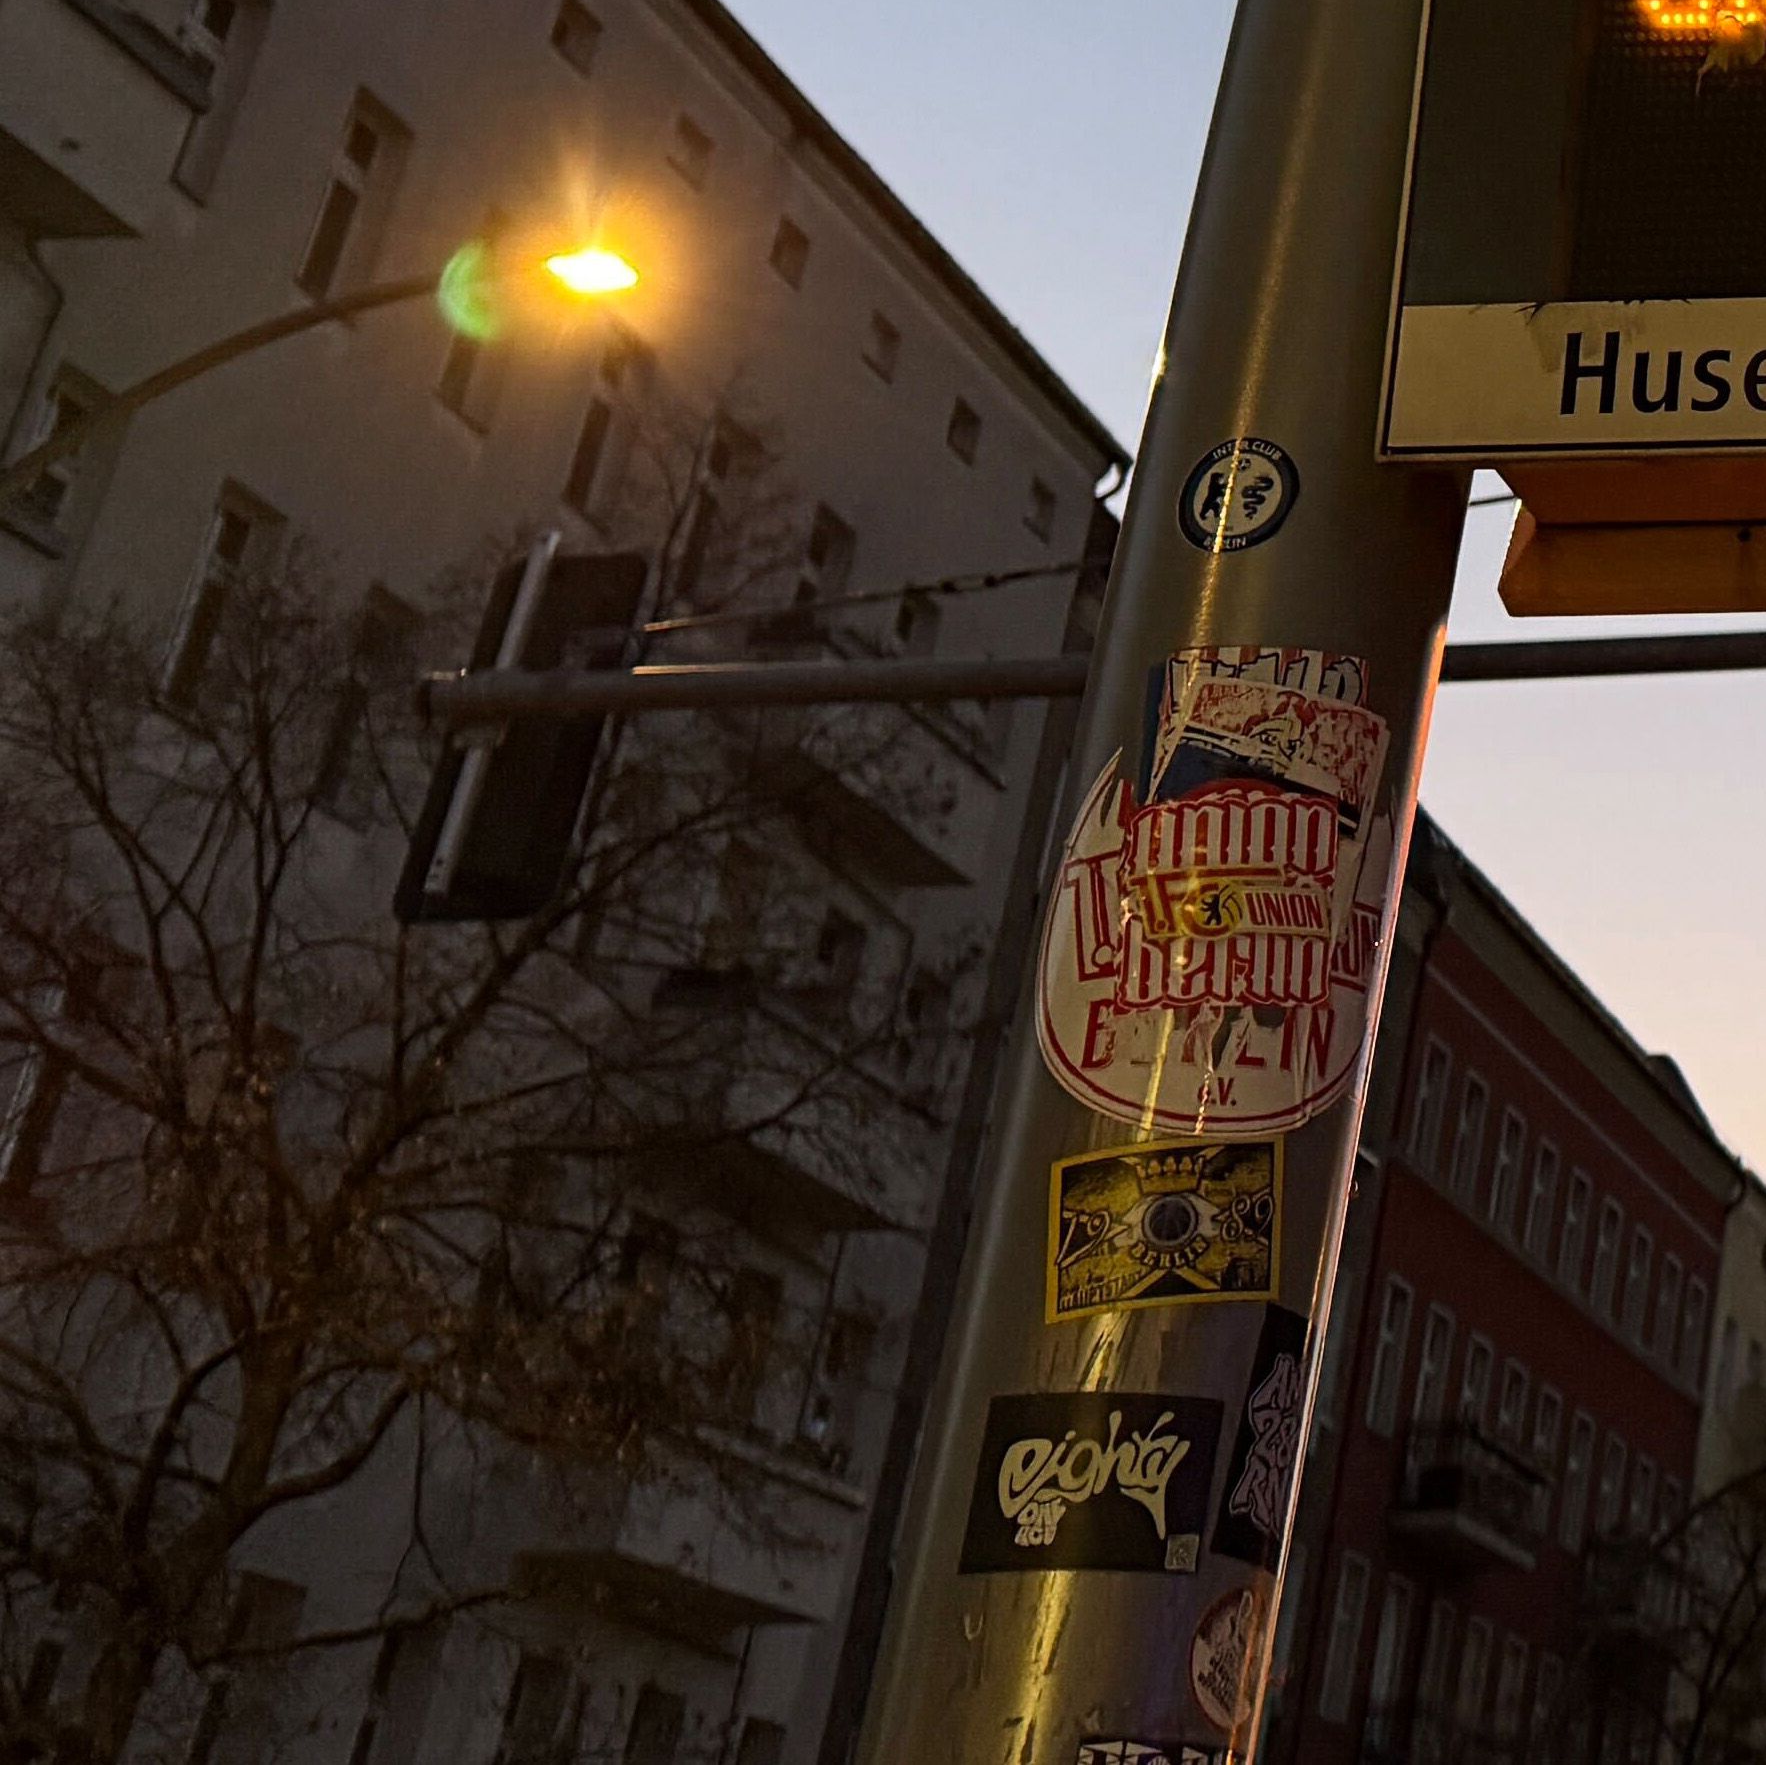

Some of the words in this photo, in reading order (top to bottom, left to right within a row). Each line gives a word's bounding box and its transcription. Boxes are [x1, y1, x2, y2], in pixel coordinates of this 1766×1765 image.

[1212, 439, 1250, 460] INTR
[1251, 440, 1283, 461] CLUB
[1244, 892, 1323, 930] UNION
[1129, 1236, 1207, 1270] BERLIN
